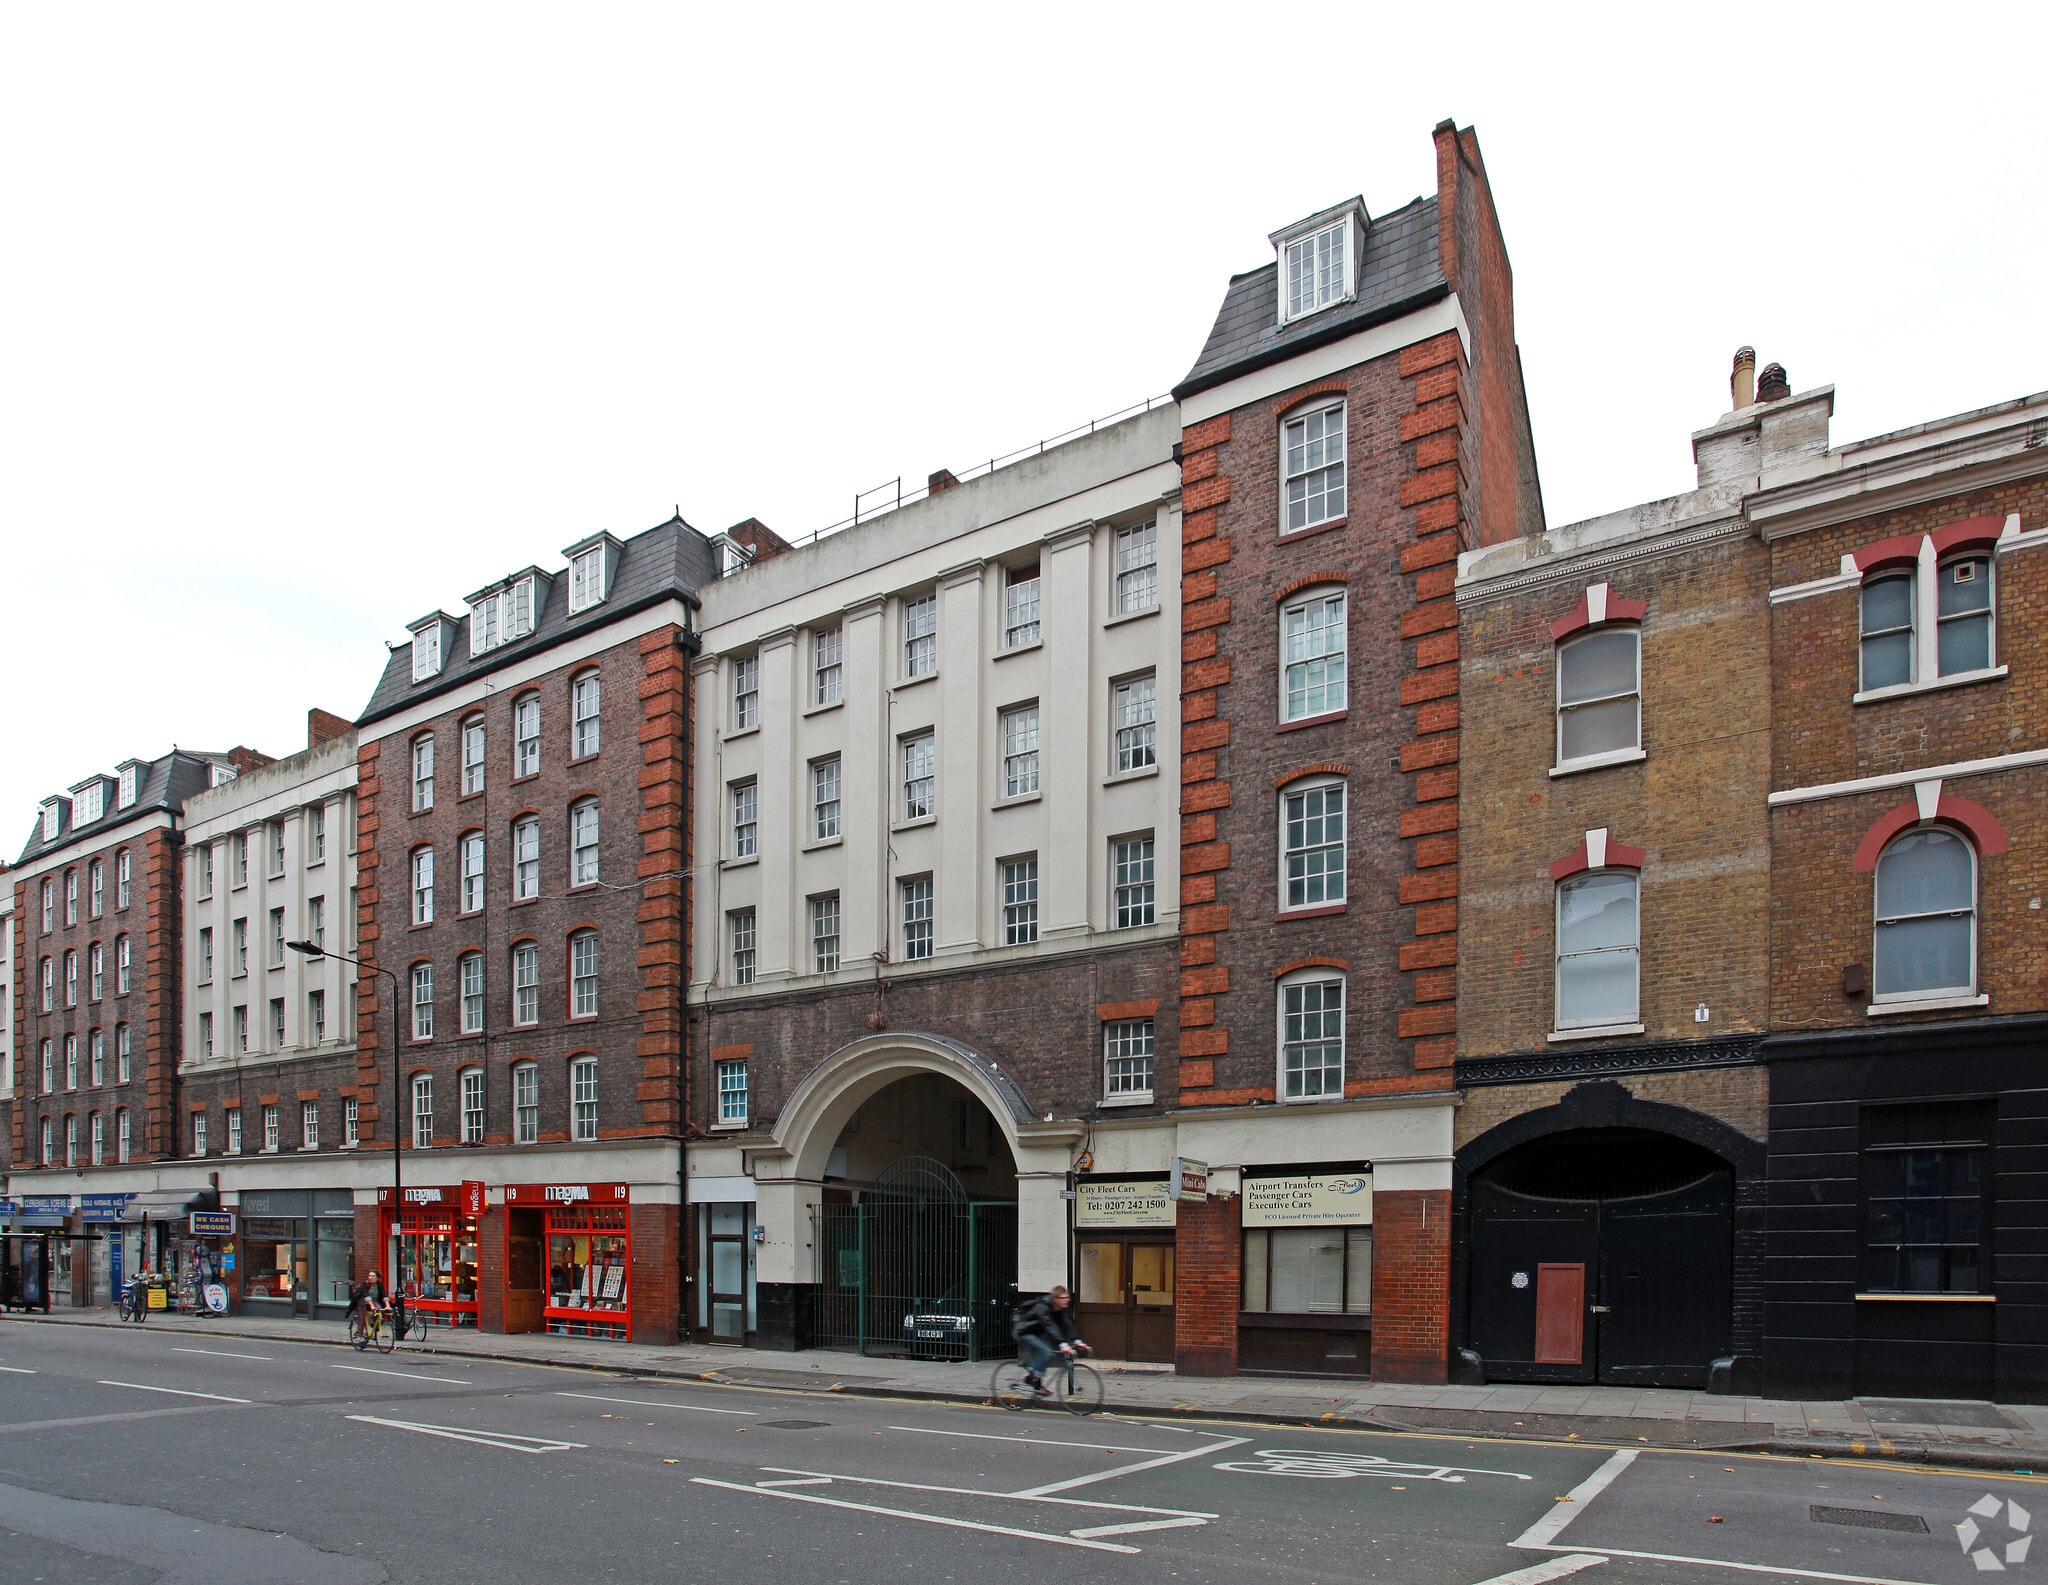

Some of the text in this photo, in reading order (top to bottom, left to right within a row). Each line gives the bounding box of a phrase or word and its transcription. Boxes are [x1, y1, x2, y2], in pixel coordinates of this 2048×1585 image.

[1182, 1177, 1205, 1189] Mini Cabs
[1249, 1180, 1324, 1192] Airport Transfers
[1334, 1180, 1357, 1188] Fleet
[380, 1190, 388, 1200] 117
[507, 1188, 516, 1200] 119
[614, 1186, 626, 1198] 119
[1080, 1186, 1095, 1195] City
[1249, 1192, 1290, 1200] Passenger
[1087, 1200, 1166, 1210] Tel: 0207 242 1500
[1248, 1201, 1290, 1210] Executive
